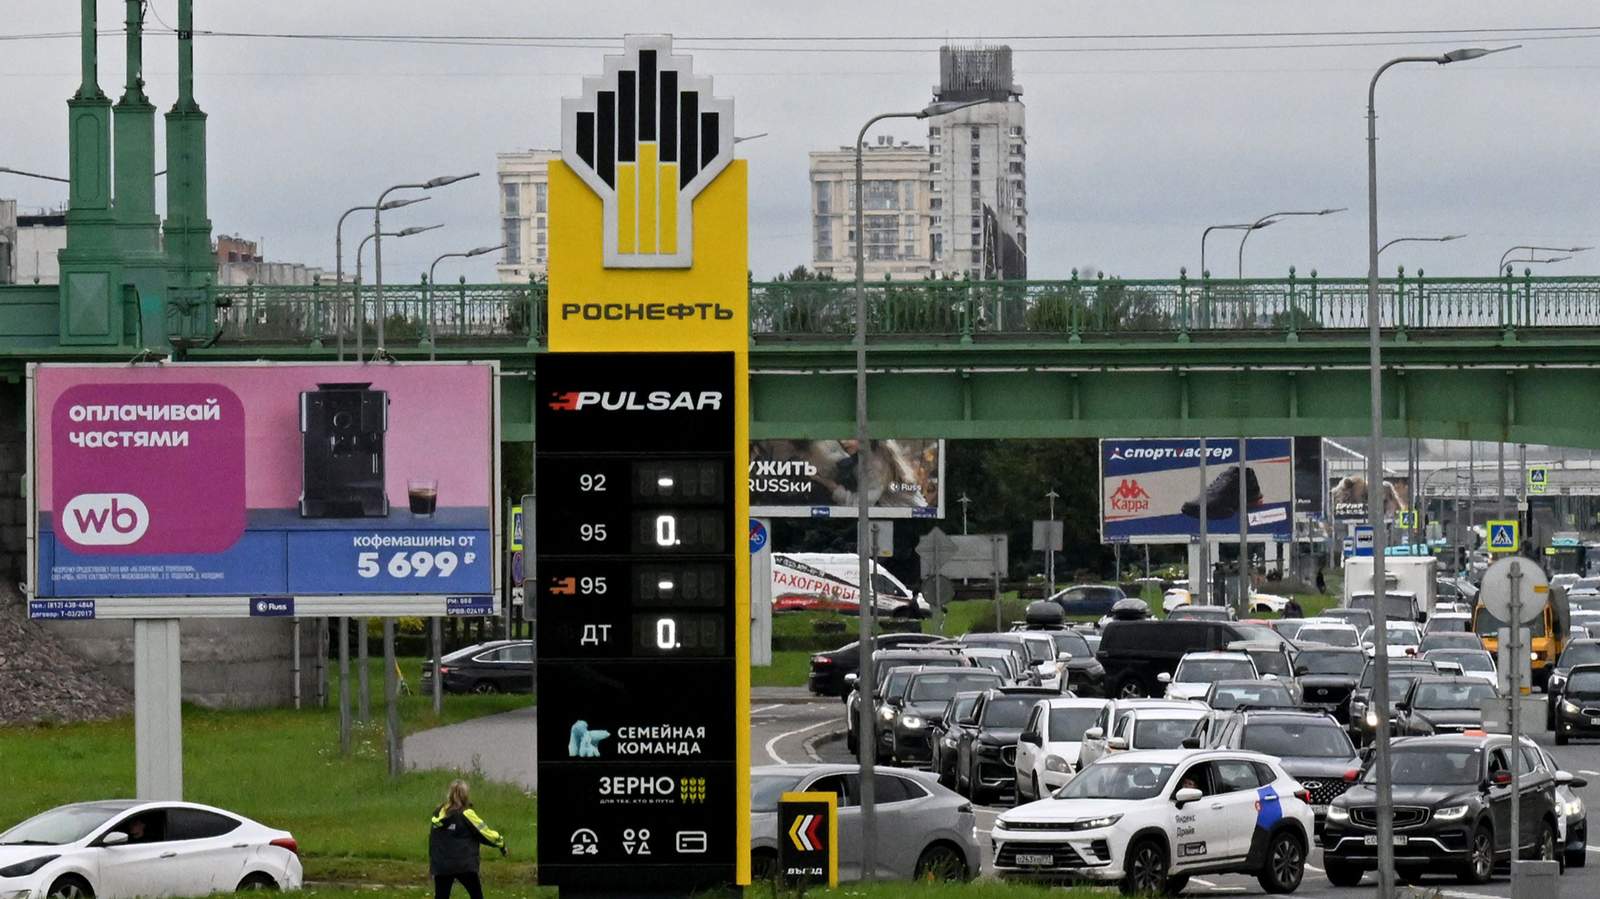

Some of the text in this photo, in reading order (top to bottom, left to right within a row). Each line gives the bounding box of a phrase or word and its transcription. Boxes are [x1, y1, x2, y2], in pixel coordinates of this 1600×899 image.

[562, 303, 733, 320] РОСНЕФТЬ
[575, 391, 723, 411] PULSAR
[69, 398, 221, 422] оплачивай
[69, 431, 189, 448] частями
[580, 474, 606, 491] 92
[1112, 499, 1149, 512] Kappa
[73, 498, 138, 533] wb
[580, 524, 607, 541] 95
[354, 534, 475, 549] кофемашины от
[358, 552, 379, 578] 5
[388, 551, 458, 578] 699
[580, 577, 607, 594] 95
[773, 570, 856, 600] ТАХОГРАФЫ
[268, 602, 287, 610] Russ
[581, 624, 612, 645] ДТ
[617, 724, 705, 739] СЕМЕЙНАЯ
[617, 742, 701, 755] КОМАНДА
[599, 776, 675, 795] ЗЕРНО
[572, 844, 598, 854] 24
